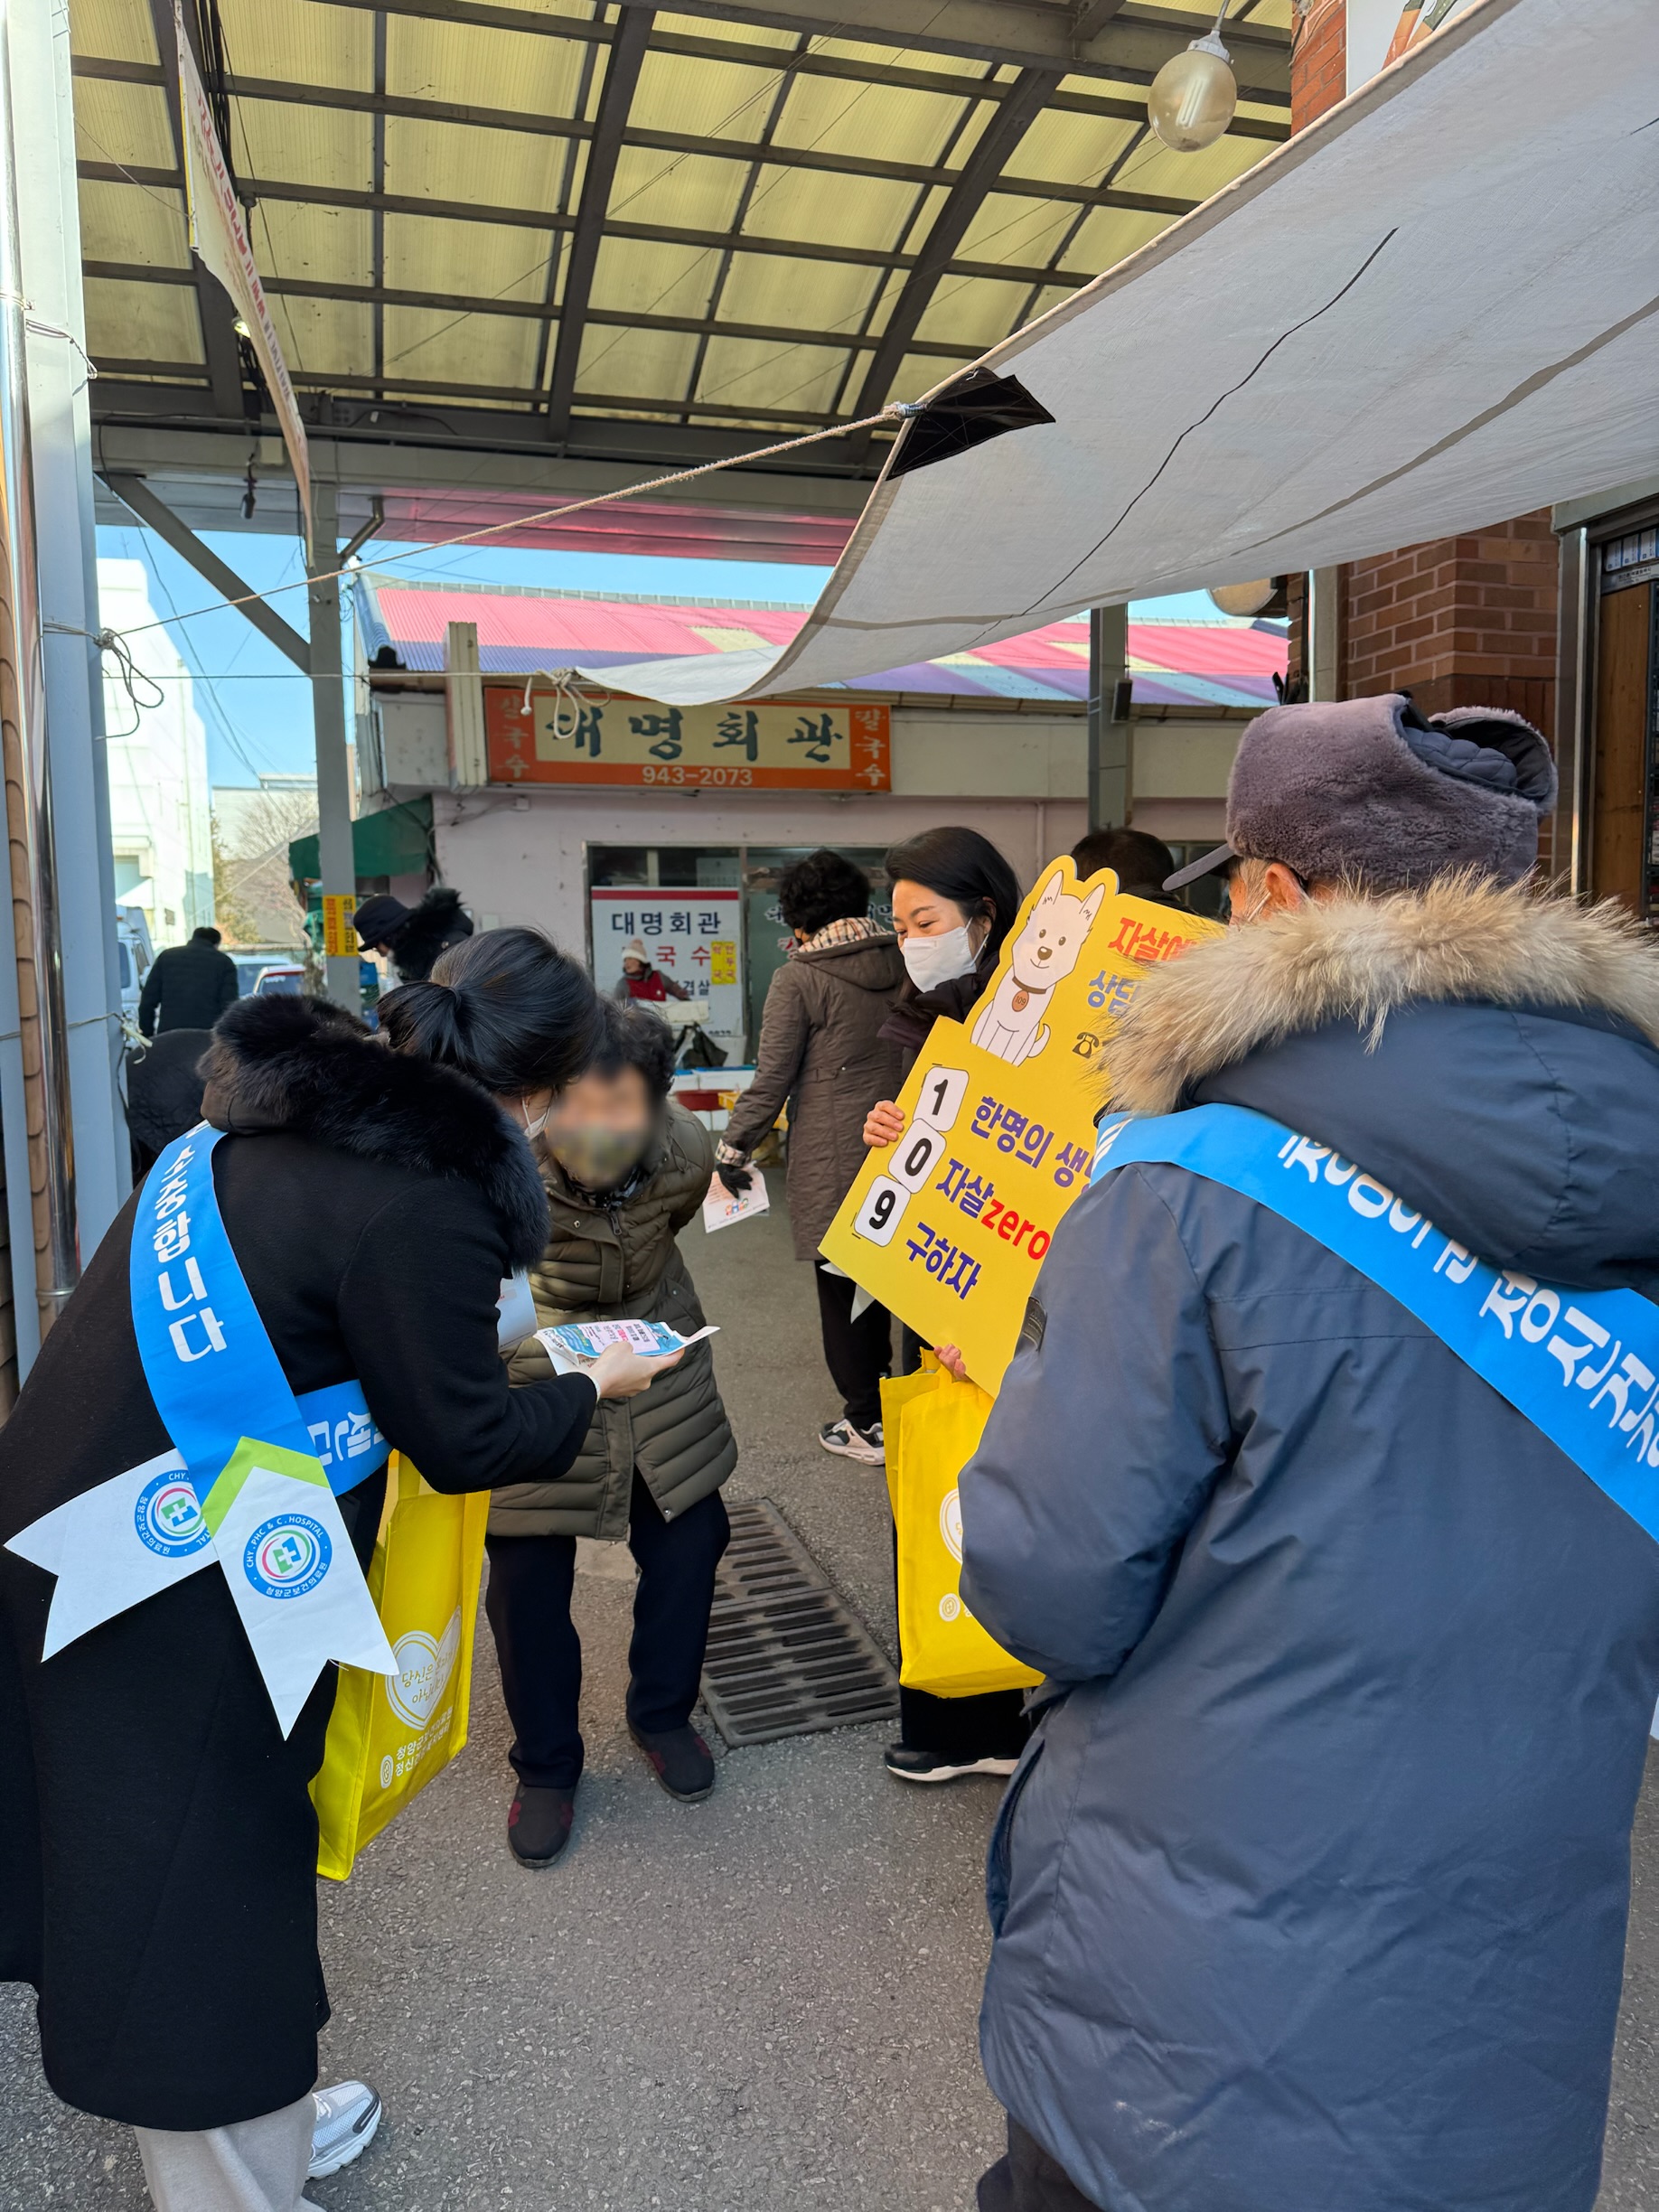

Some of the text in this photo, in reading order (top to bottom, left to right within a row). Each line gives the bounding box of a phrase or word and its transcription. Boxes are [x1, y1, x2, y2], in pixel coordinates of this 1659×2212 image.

[642, 766, 753, 786] 943-2073
[612, 912, 721, 935] 대명회관
[970, 1096, 1094, 1194] 한명의 생
[905, 1222, 982, 1300] 구하자
[401, 1664, 434, 1688] 당신은
